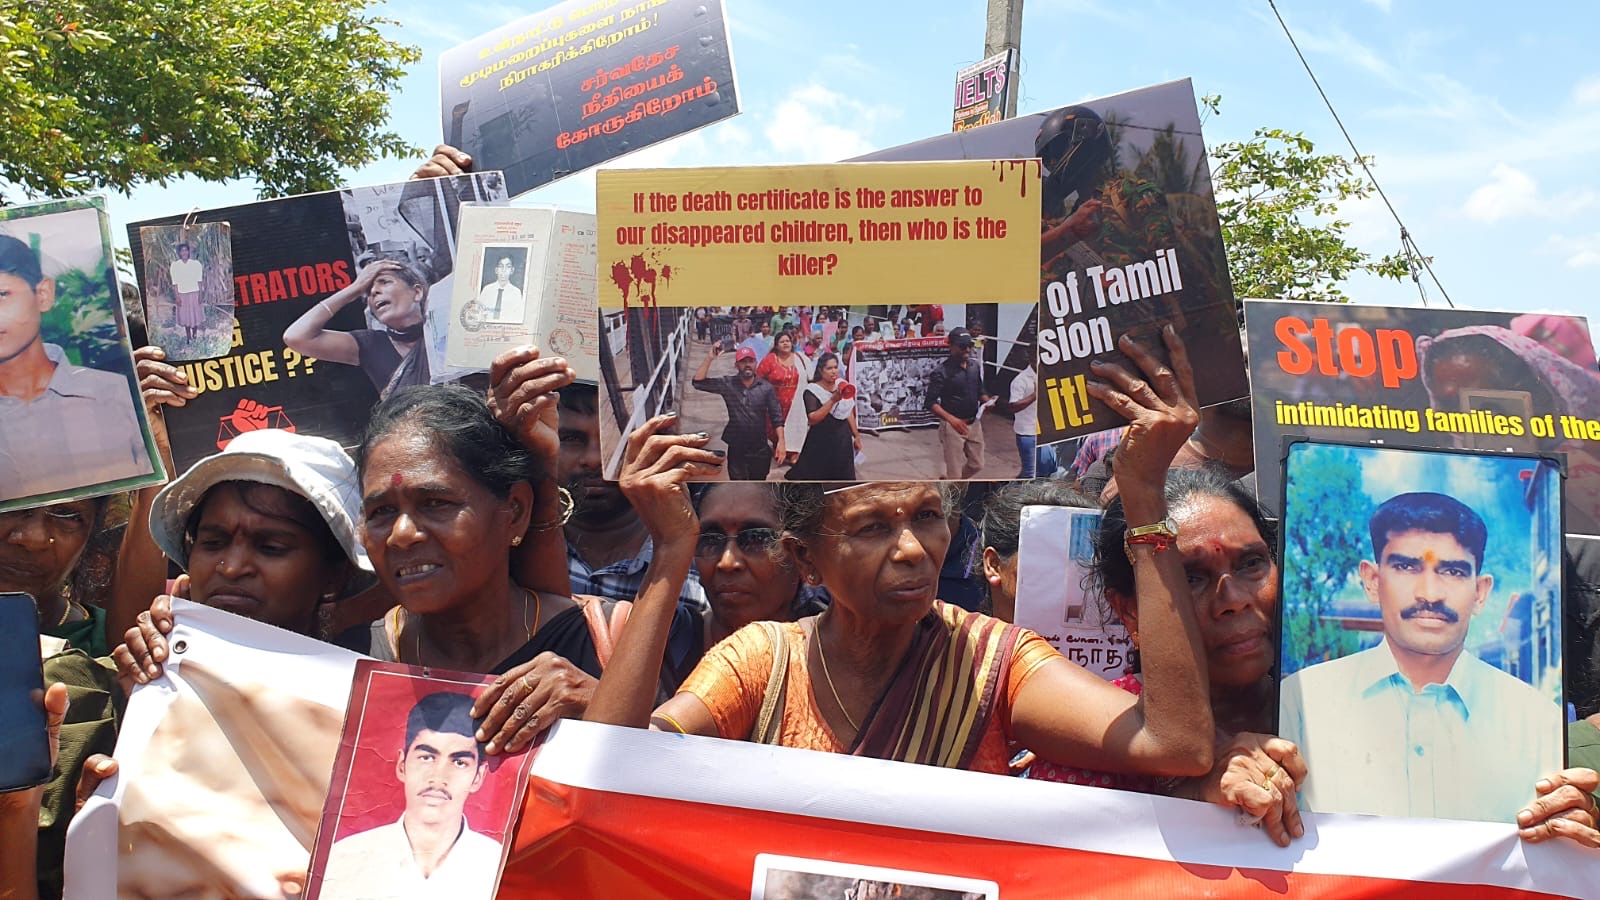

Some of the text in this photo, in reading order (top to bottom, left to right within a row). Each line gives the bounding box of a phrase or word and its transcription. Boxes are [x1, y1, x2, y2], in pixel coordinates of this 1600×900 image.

[580, 45, 681, 92] சர்வதேச
[581, 64, 685, 120] நீதியைக்
[955, 63, 1006, 109] IELTS
[556, 76, 718, 150] கோருகிறோம்
[633, 185, 983, 214] If the death certificate is the answer to
[616, 226, 645, 246] our
[651, 221, 765, 248] disappeared
[770, 219, 853, 244] children,
[858, 218, 902, 242] then
[906, 217, 949, 240] who
[953, 216, 971, 240] is
[975, 216, 1007, 240] the
[233, 259, 352, 308] TRATORS
[778, 252, 838, 276] killer?
[1046, 248, 1183, 318] of Tamil
[1038, 315, 1114, 366] sion
[1274, 316, 1418, 388] Stop
[1045, 374, 1094, 431] it!
[1275, 400, 1600, 441] intimidating families of the
